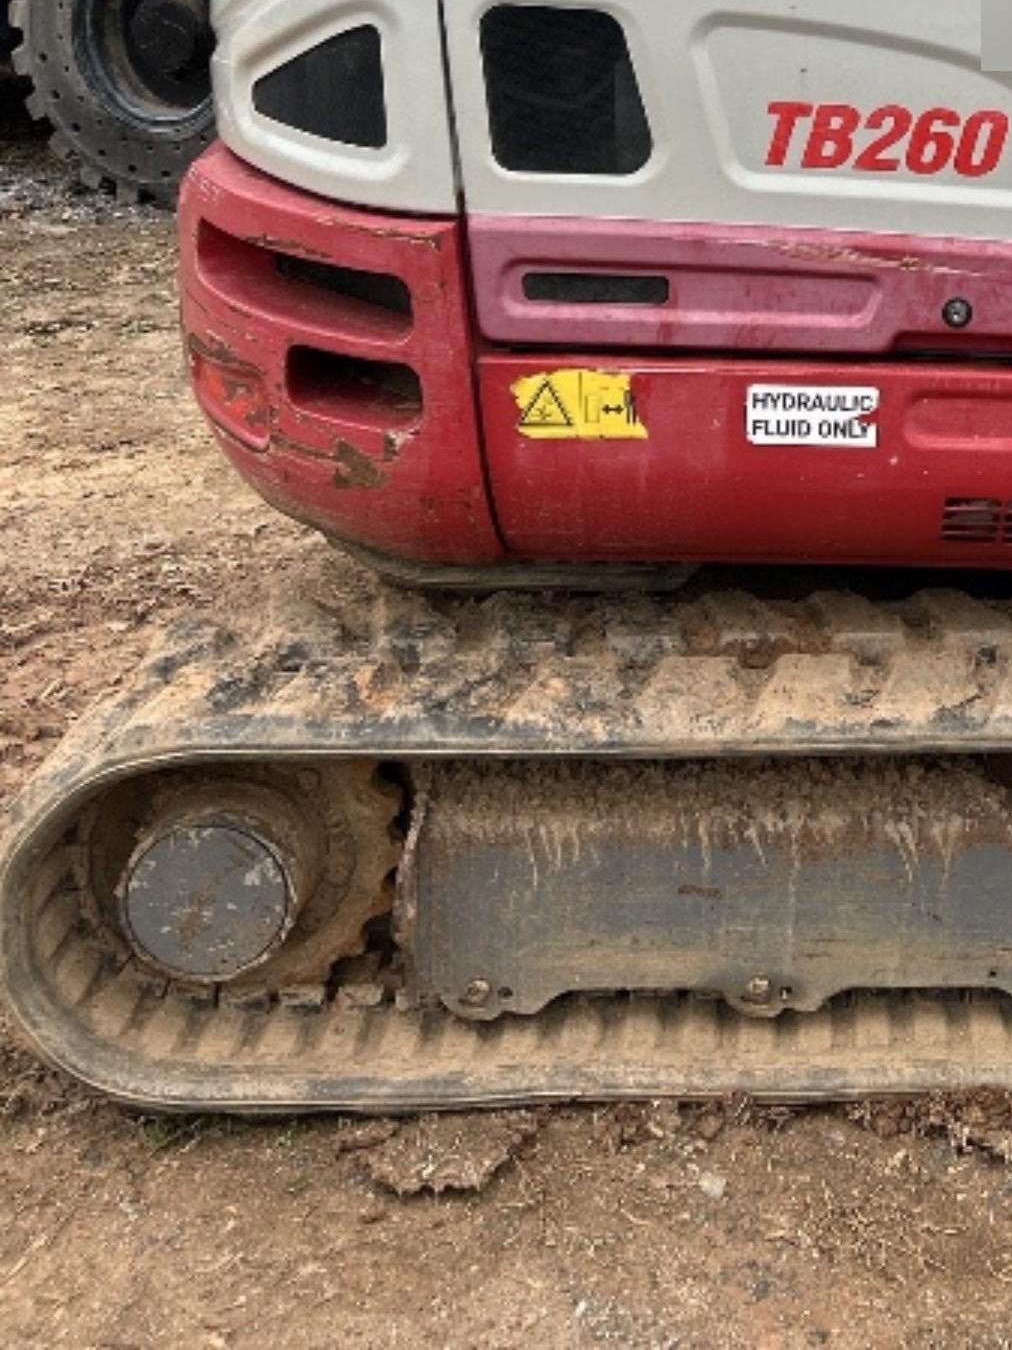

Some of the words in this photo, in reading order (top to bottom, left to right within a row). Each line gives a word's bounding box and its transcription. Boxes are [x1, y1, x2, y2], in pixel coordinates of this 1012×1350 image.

[764, 101, 1009, 176] TB260
[751, 392, 874, 412] HYDRAULIC
[752, 419, 811, 438] FLUID
